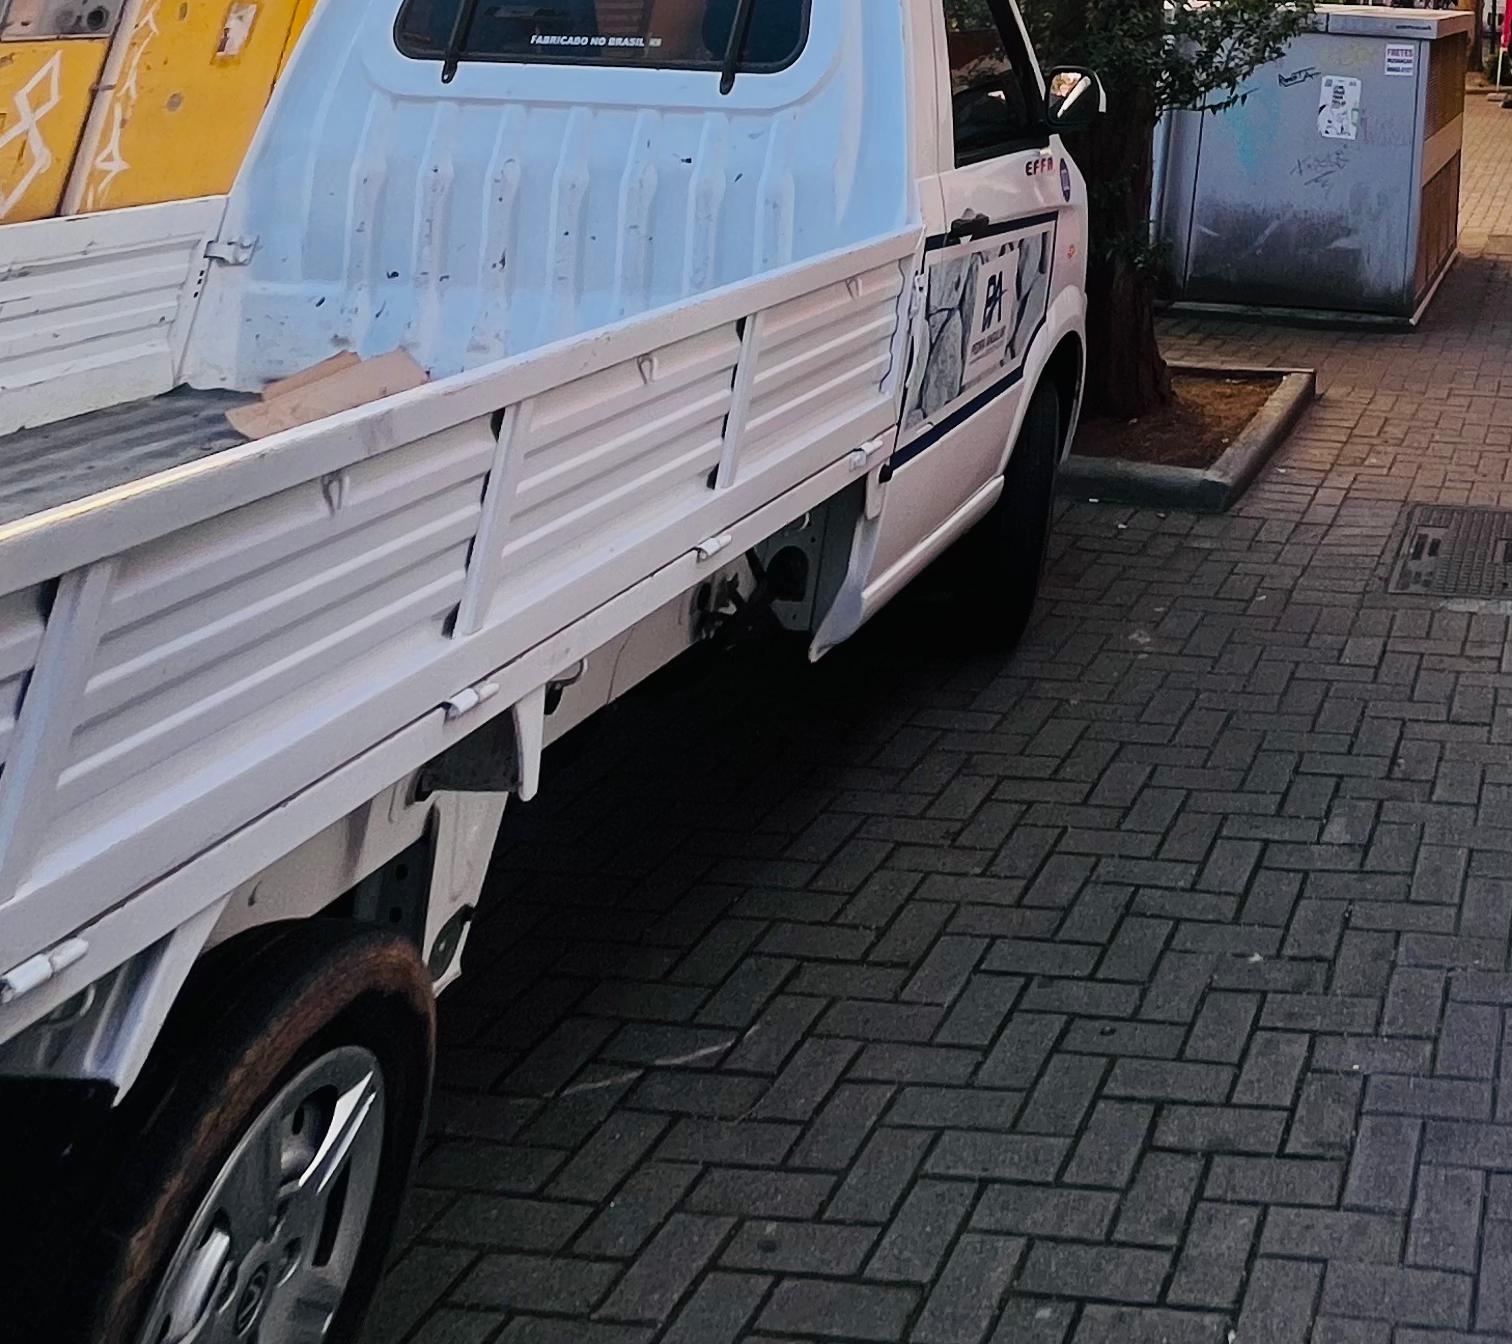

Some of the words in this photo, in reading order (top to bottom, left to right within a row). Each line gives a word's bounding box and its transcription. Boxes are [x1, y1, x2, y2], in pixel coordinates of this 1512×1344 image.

[530, 35, 588, 45] FABRICADO
[590, 37, 606, 46] NO
[608, 37, 645, 47] BRASIL
